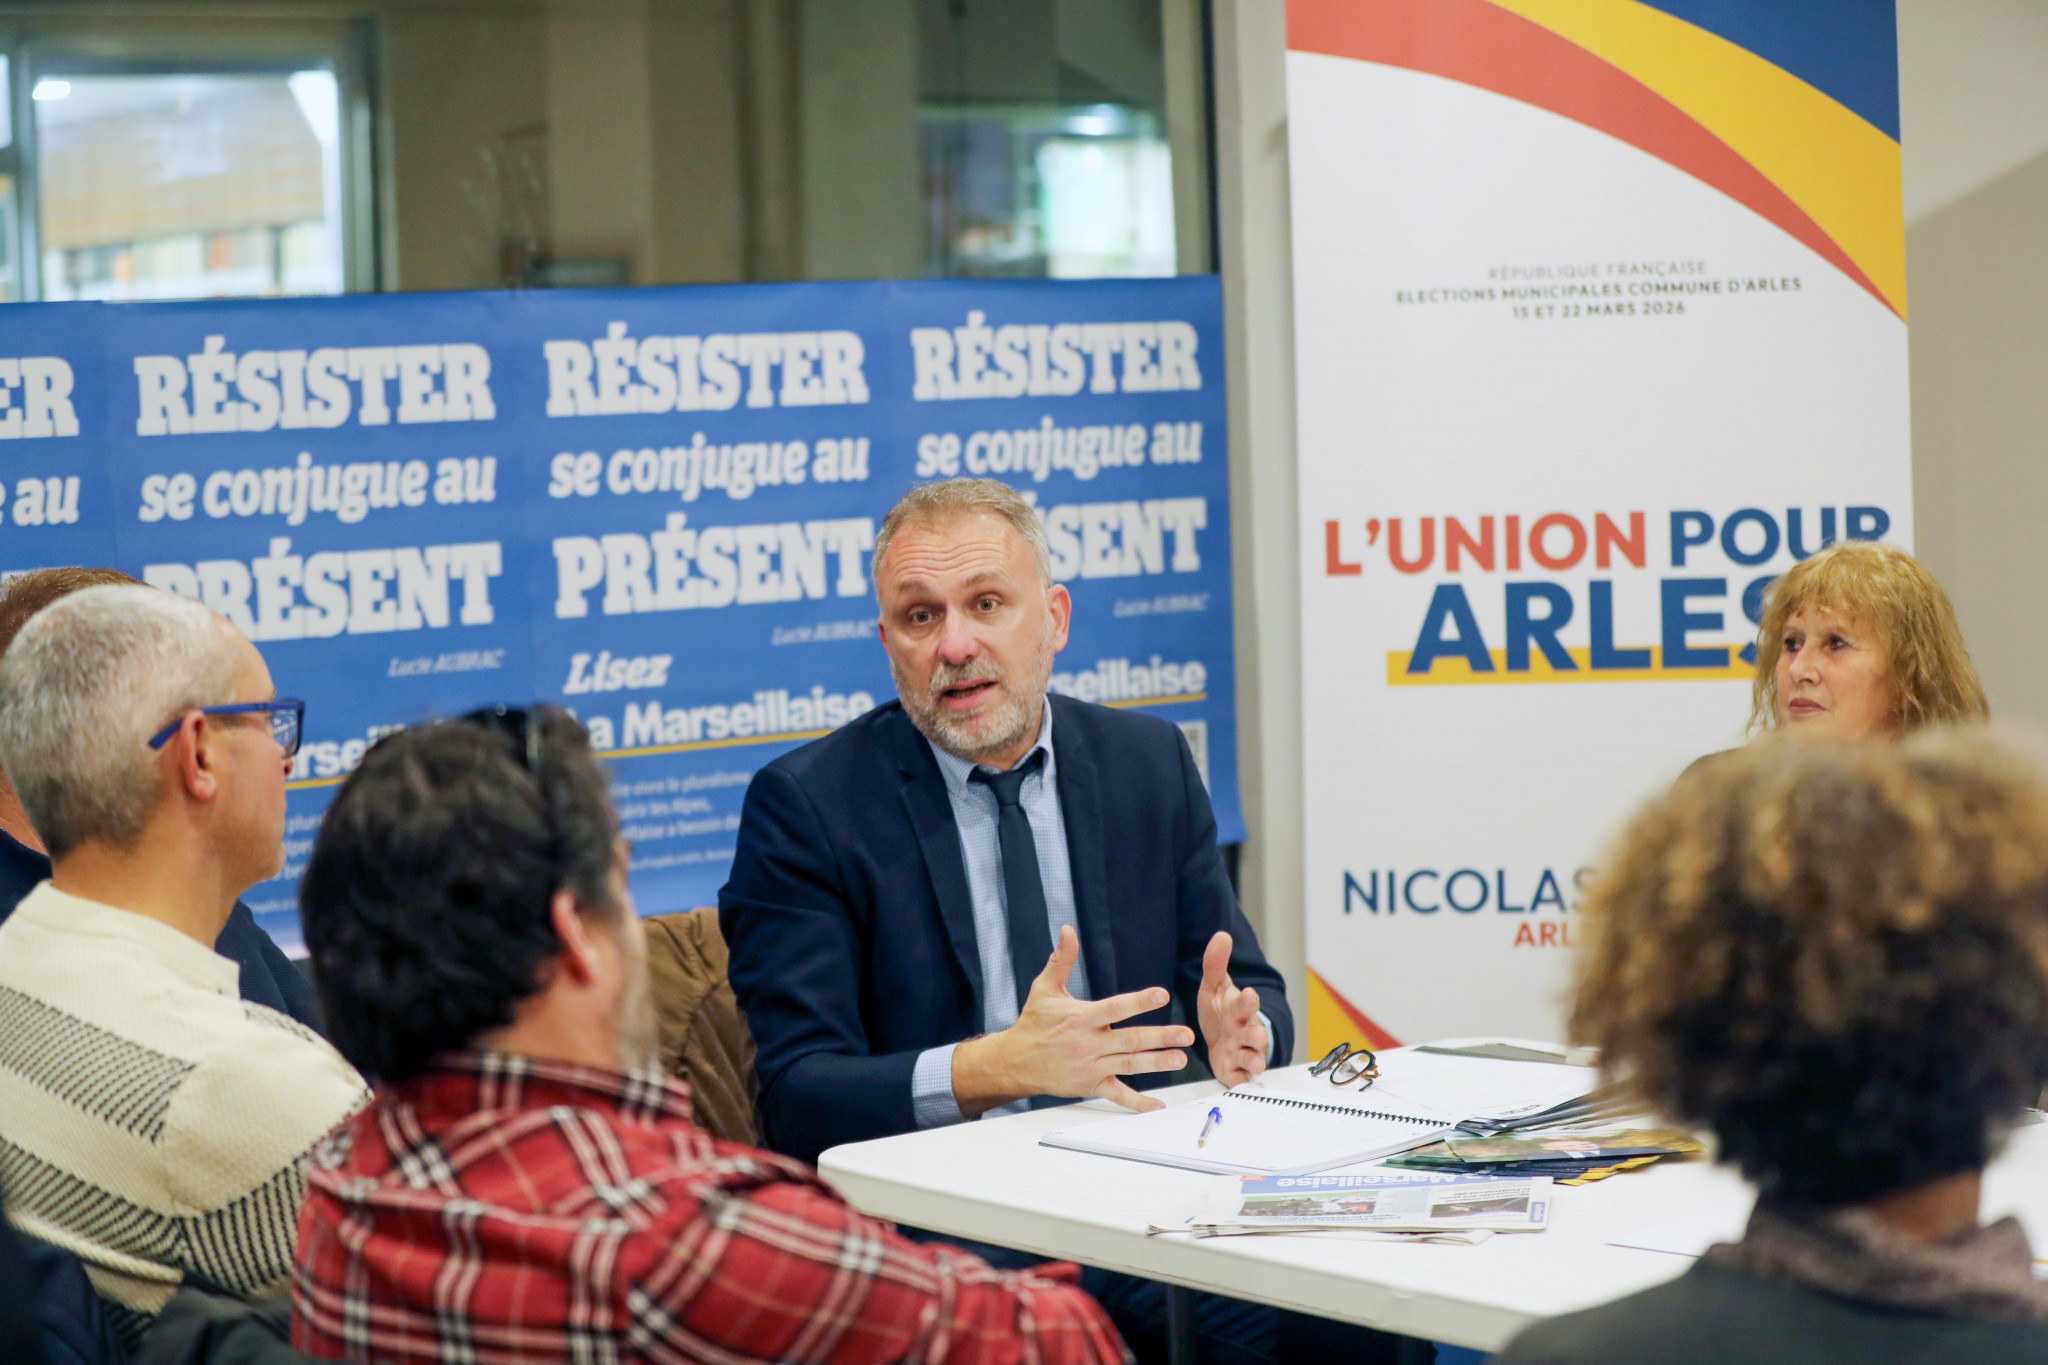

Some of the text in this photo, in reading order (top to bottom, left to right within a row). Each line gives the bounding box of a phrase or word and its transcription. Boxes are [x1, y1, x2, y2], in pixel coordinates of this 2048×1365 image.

[1397, 277, 1801, 304] ELECTIONS MUNICIPALES COMMUNE D'ARLES
[1488, 261, 1706, 281] RÉPUBLIQUE FRANÇAISE
[1513, 301, 1685, 319] 15 ET 22 MARS 2026
[134, 335, 496, 437] RÉSISTER
[544, 322, 870, 418] RÉSISTER
[911, 310, 1201, 402] RÉSISTER
[548, 433, 870, 502] se conjugue au
[916, 416, 1202, 483] se conjugue au
[12, 476, 80, 526] au
[139, 452, 497, 526] se conjugue au
[553, 512, 874, 619] PRÉSENT
[1036, 492, 1207, 581] SENT
[1669, 506, 1891, 567] POUR
[563, 650, 672, 695] Lisez
[1051, 655, 1206, 702] seillaise
[622, 686, 874, 748] Marseillaise
